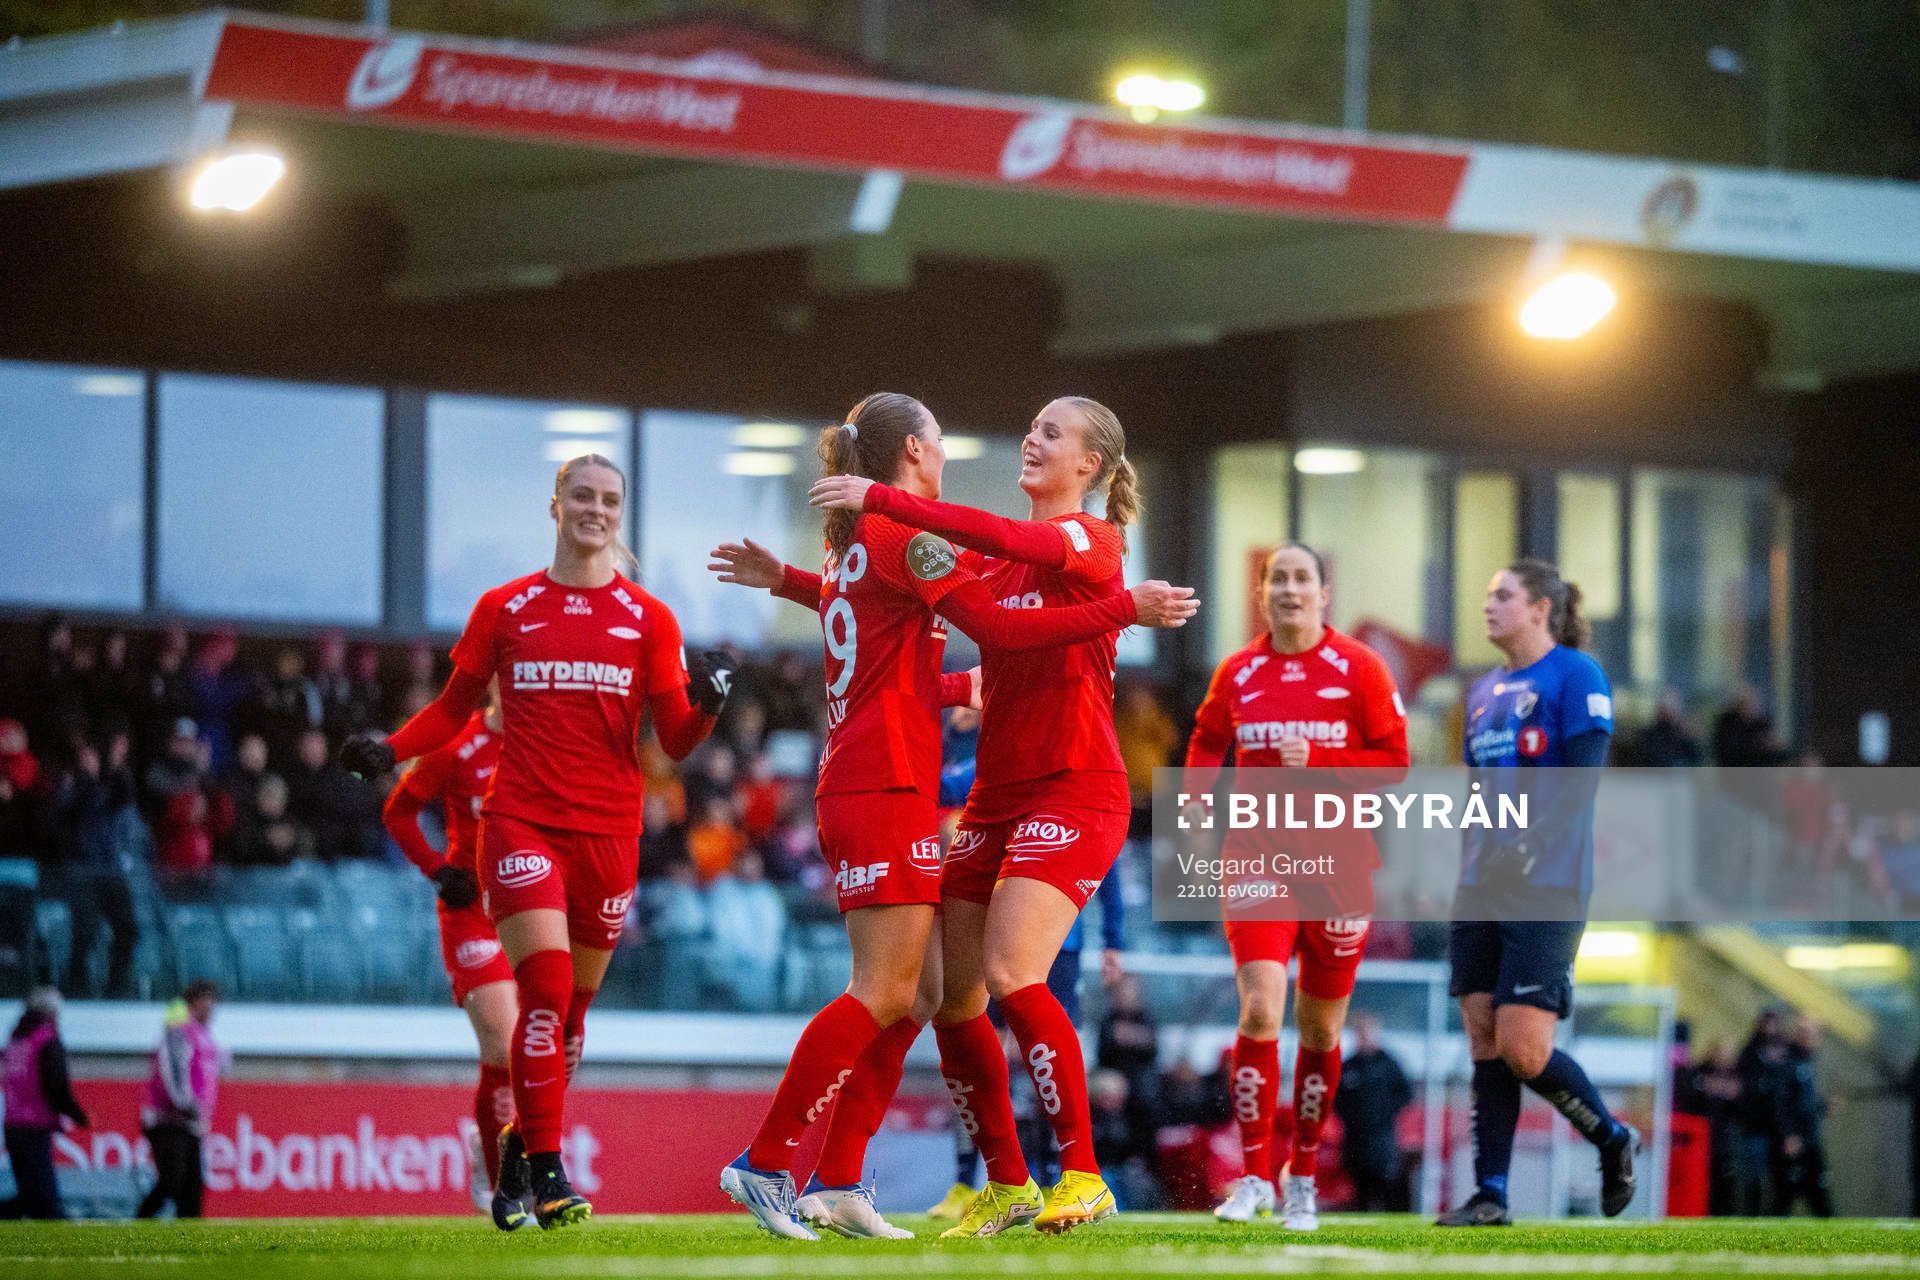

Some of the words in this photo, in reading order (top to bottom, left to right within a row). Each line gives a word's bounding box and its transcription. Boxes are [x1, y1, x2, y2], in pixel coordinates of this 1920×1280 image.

[922, 552, 950, 572] OBOS
[824, 597, 858, 698] 9
[1525, 731, 1539, 752] 1
[1014, 821, 1075, 842] ERØY
[911, 842, 940, 859] LER
[835, 860, 890, 890] ÅBF
[1029, 1043, 1061, 1116] coop
[1235, 1066, 1266, 1123] coop
